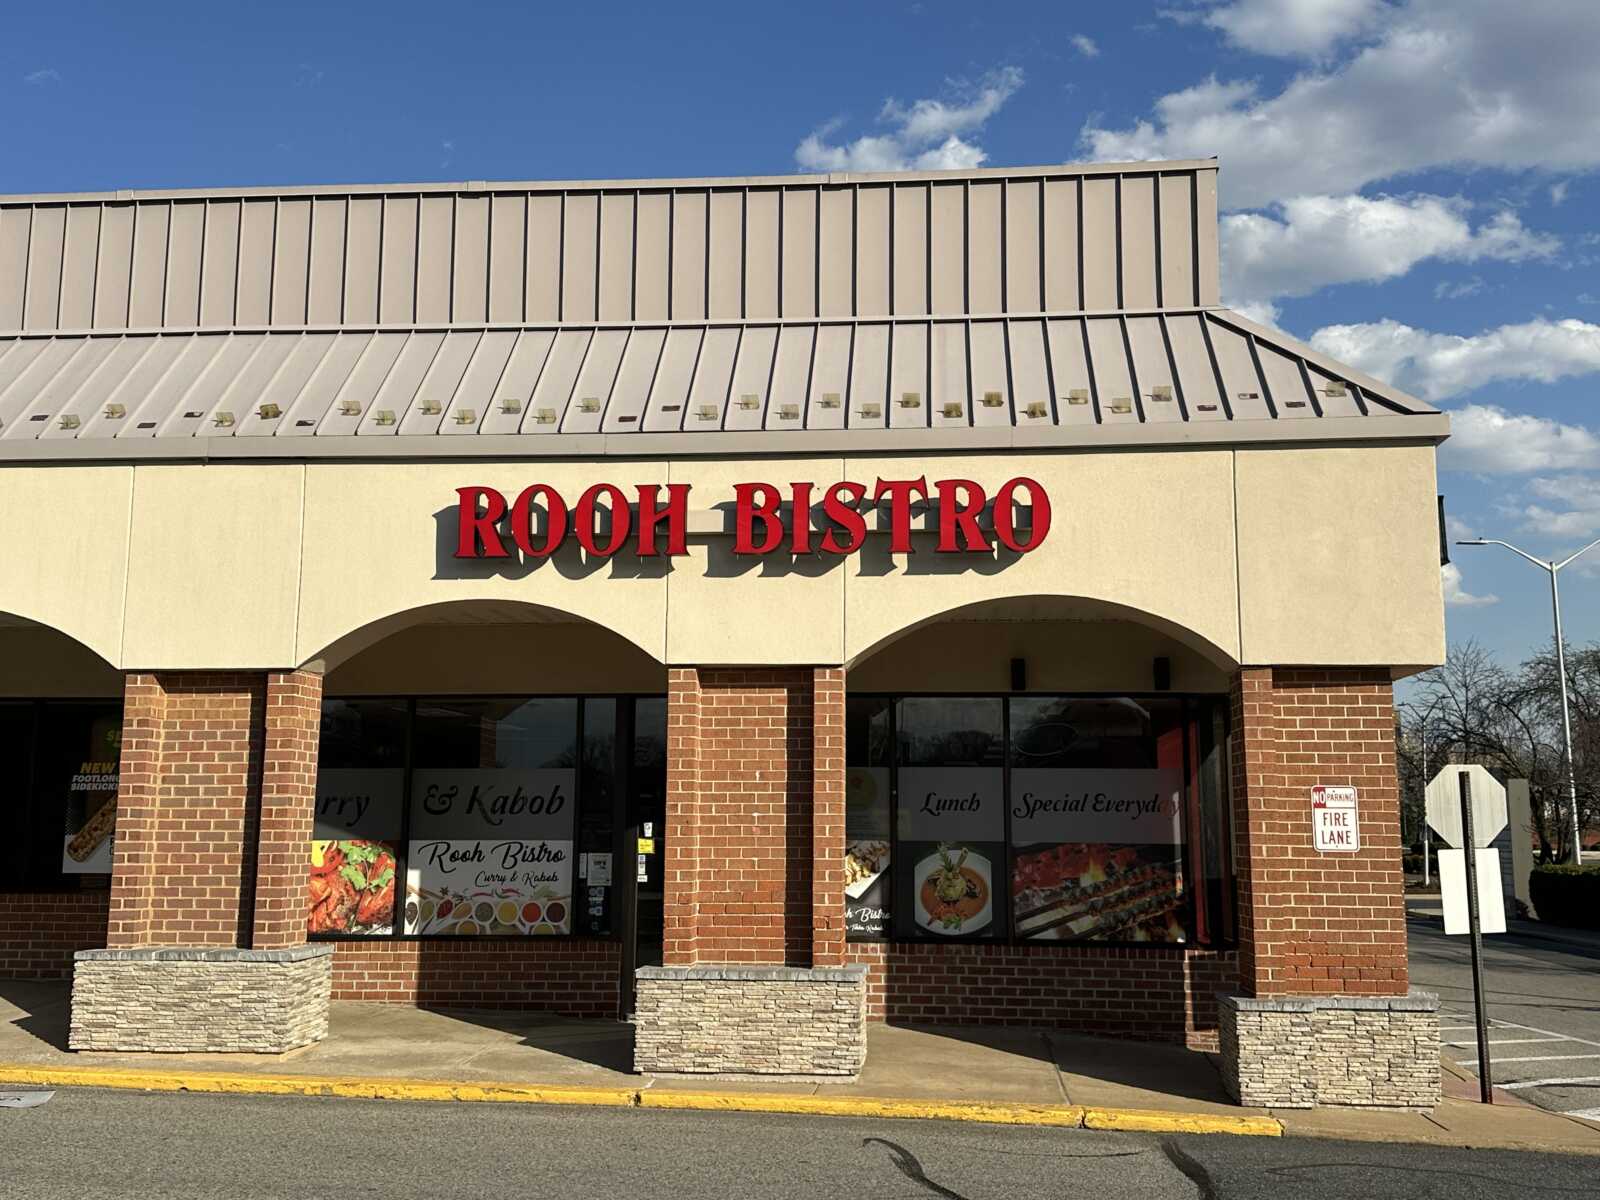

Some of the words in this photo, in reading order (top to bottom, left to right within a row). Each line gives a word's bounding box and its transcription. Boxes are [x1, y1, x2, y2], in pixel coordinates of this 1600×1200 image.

[455, 483, 692, 558] ROOH
[732, 475, 1052, 555] BISTRO
[80, 761, 117, 774] NEW
[70, 782, 118, 791] SIDEKICK
[320, 796, 370, 827] rry
[424, 784, 458, 815] &
[466, 784, 565, 826] Kabob
[920, 792, 980, 817] Lunch
[1013, 792, 1088, 819] Special
[1313, 791, 1325, 804] NO
[1326, 793, 1354, 802] PARKING
[1323, 812, 1349, 827] FIRE
[1321, 830, 1352, 845] LANE
[418, 841, 486, 872] Rooh
[491, 841, 566, 870] Bistro
[475, 870, 507, 887] Curry
